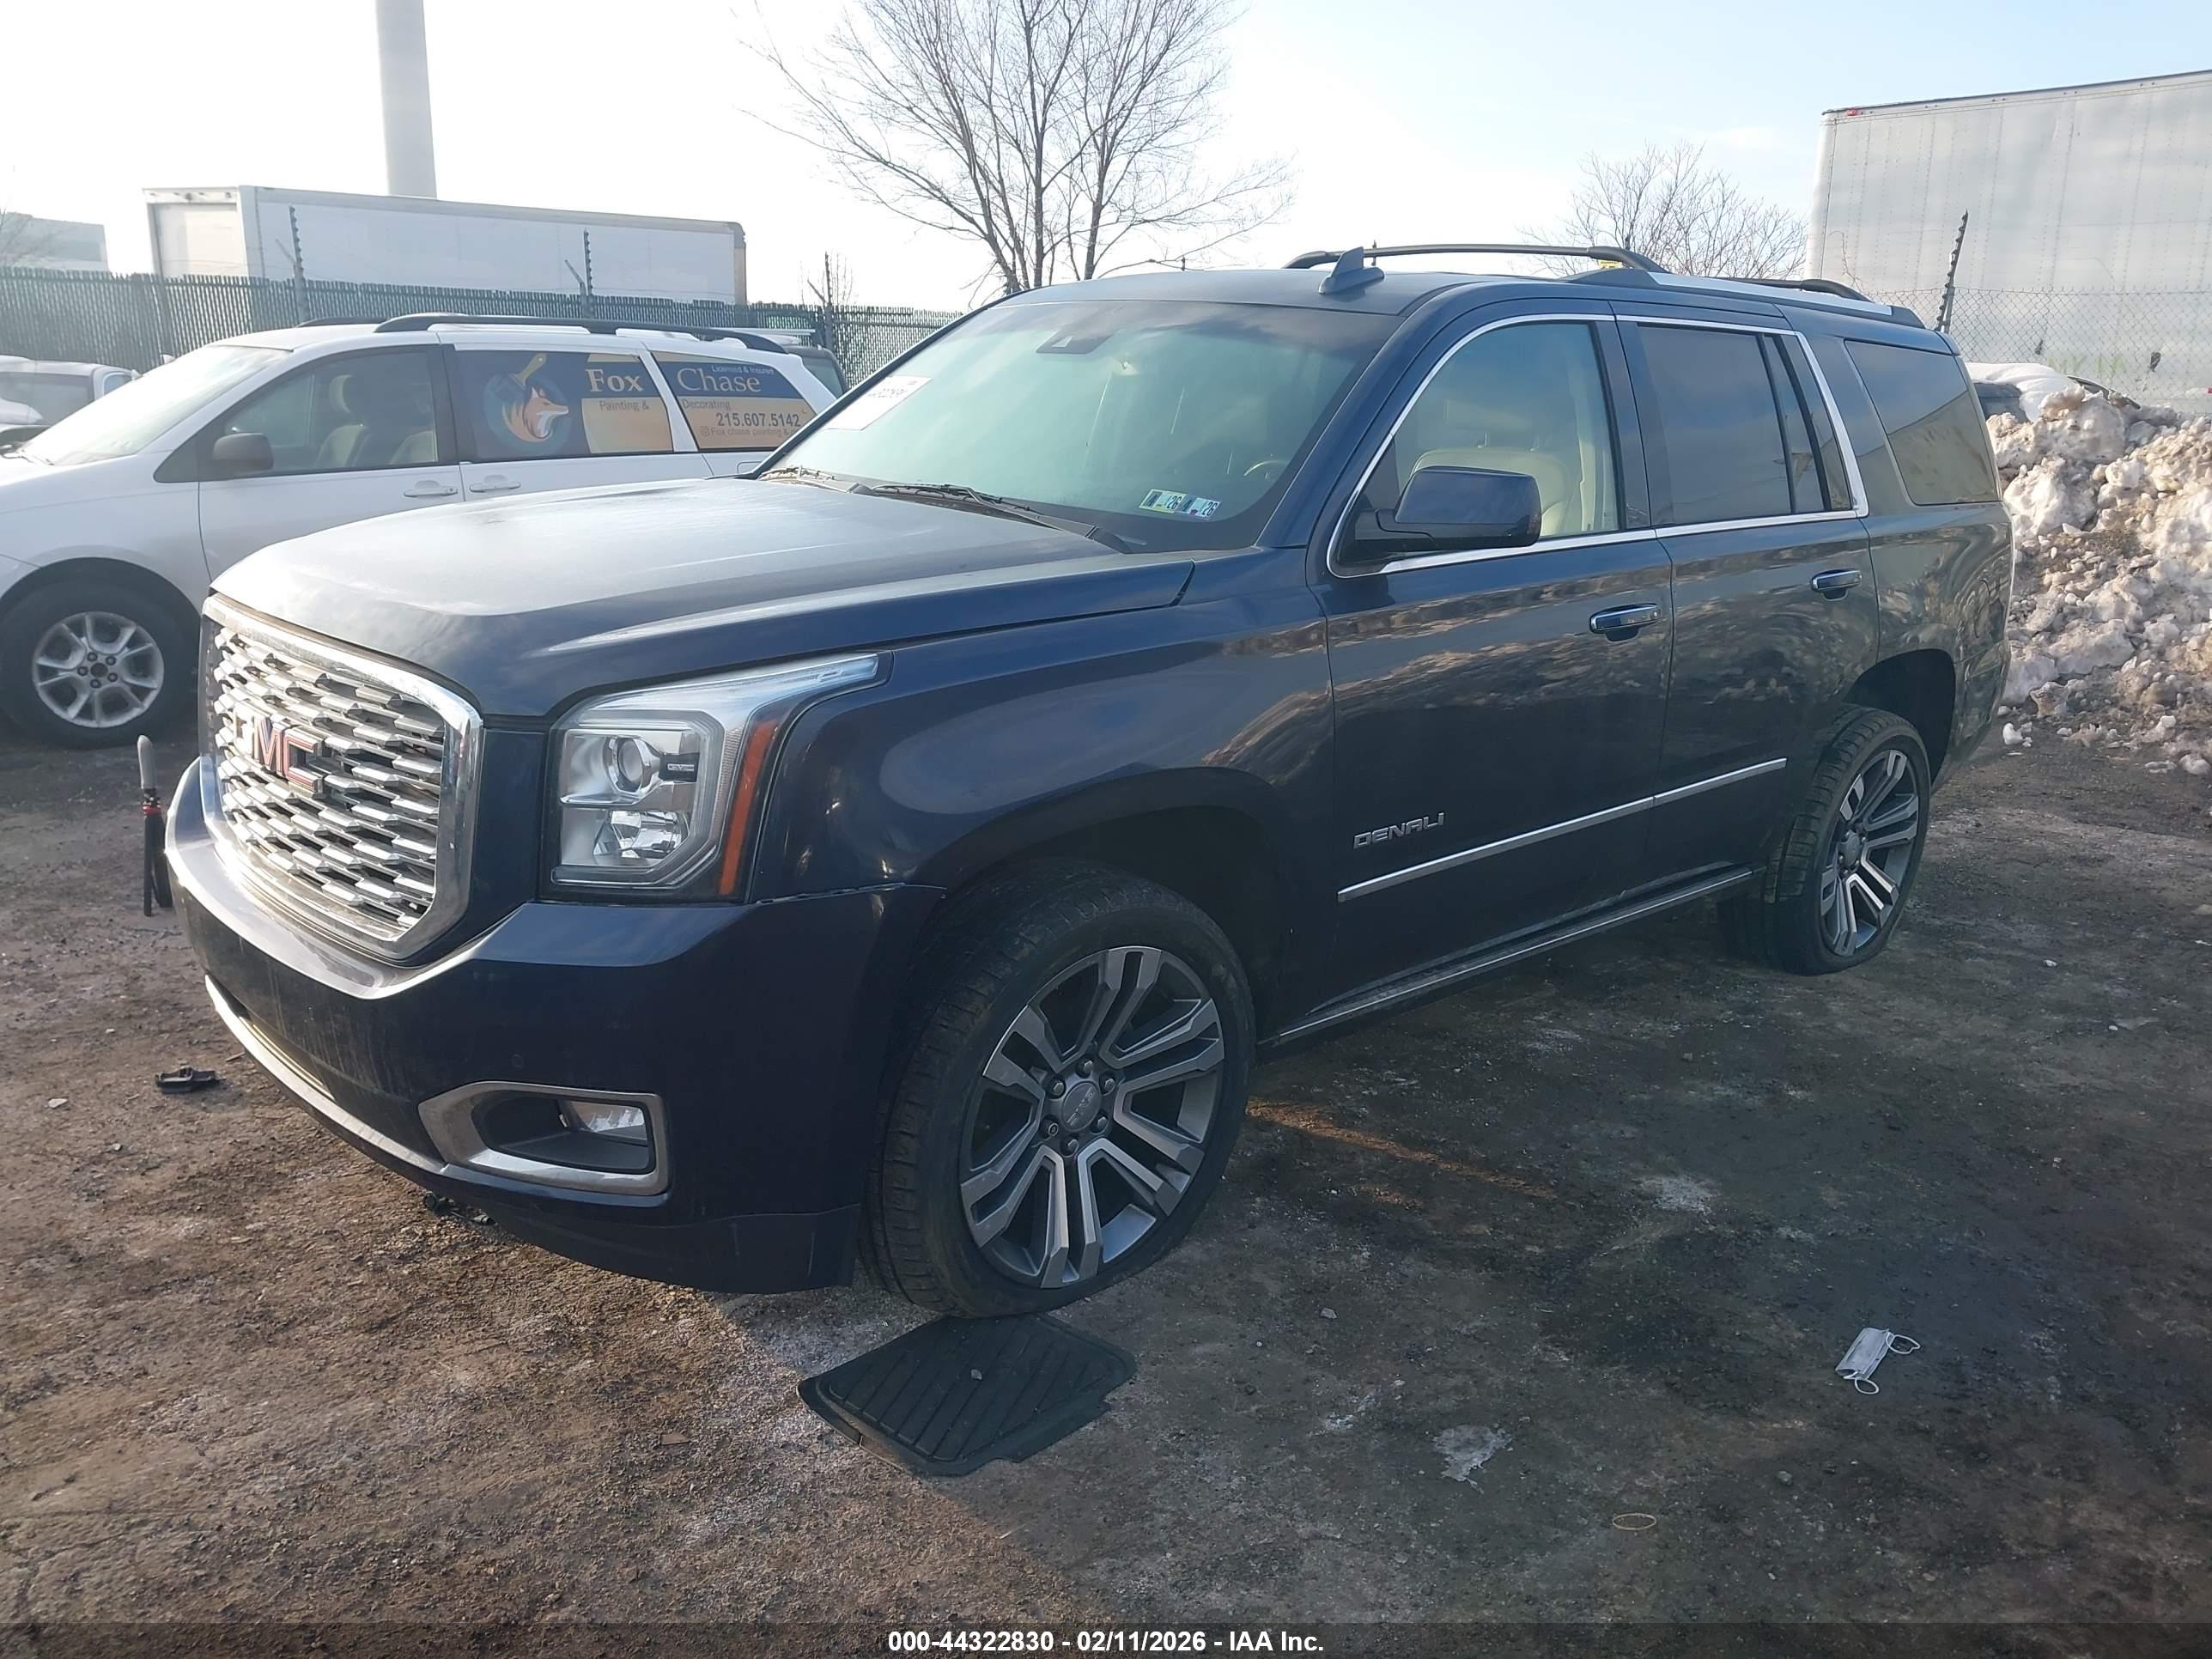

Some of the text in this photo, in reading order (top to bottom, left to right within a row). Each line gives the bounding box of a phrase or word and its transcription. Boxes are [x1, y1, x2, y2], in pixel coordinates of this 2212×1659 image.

[585, 368, 762, 392] Fox Chase
[599, 398, 730, 412] Painting & Decorating
[715, 412, 801, 428] 215.607.5142
[1353, 812, 1444, 848] DENALI
